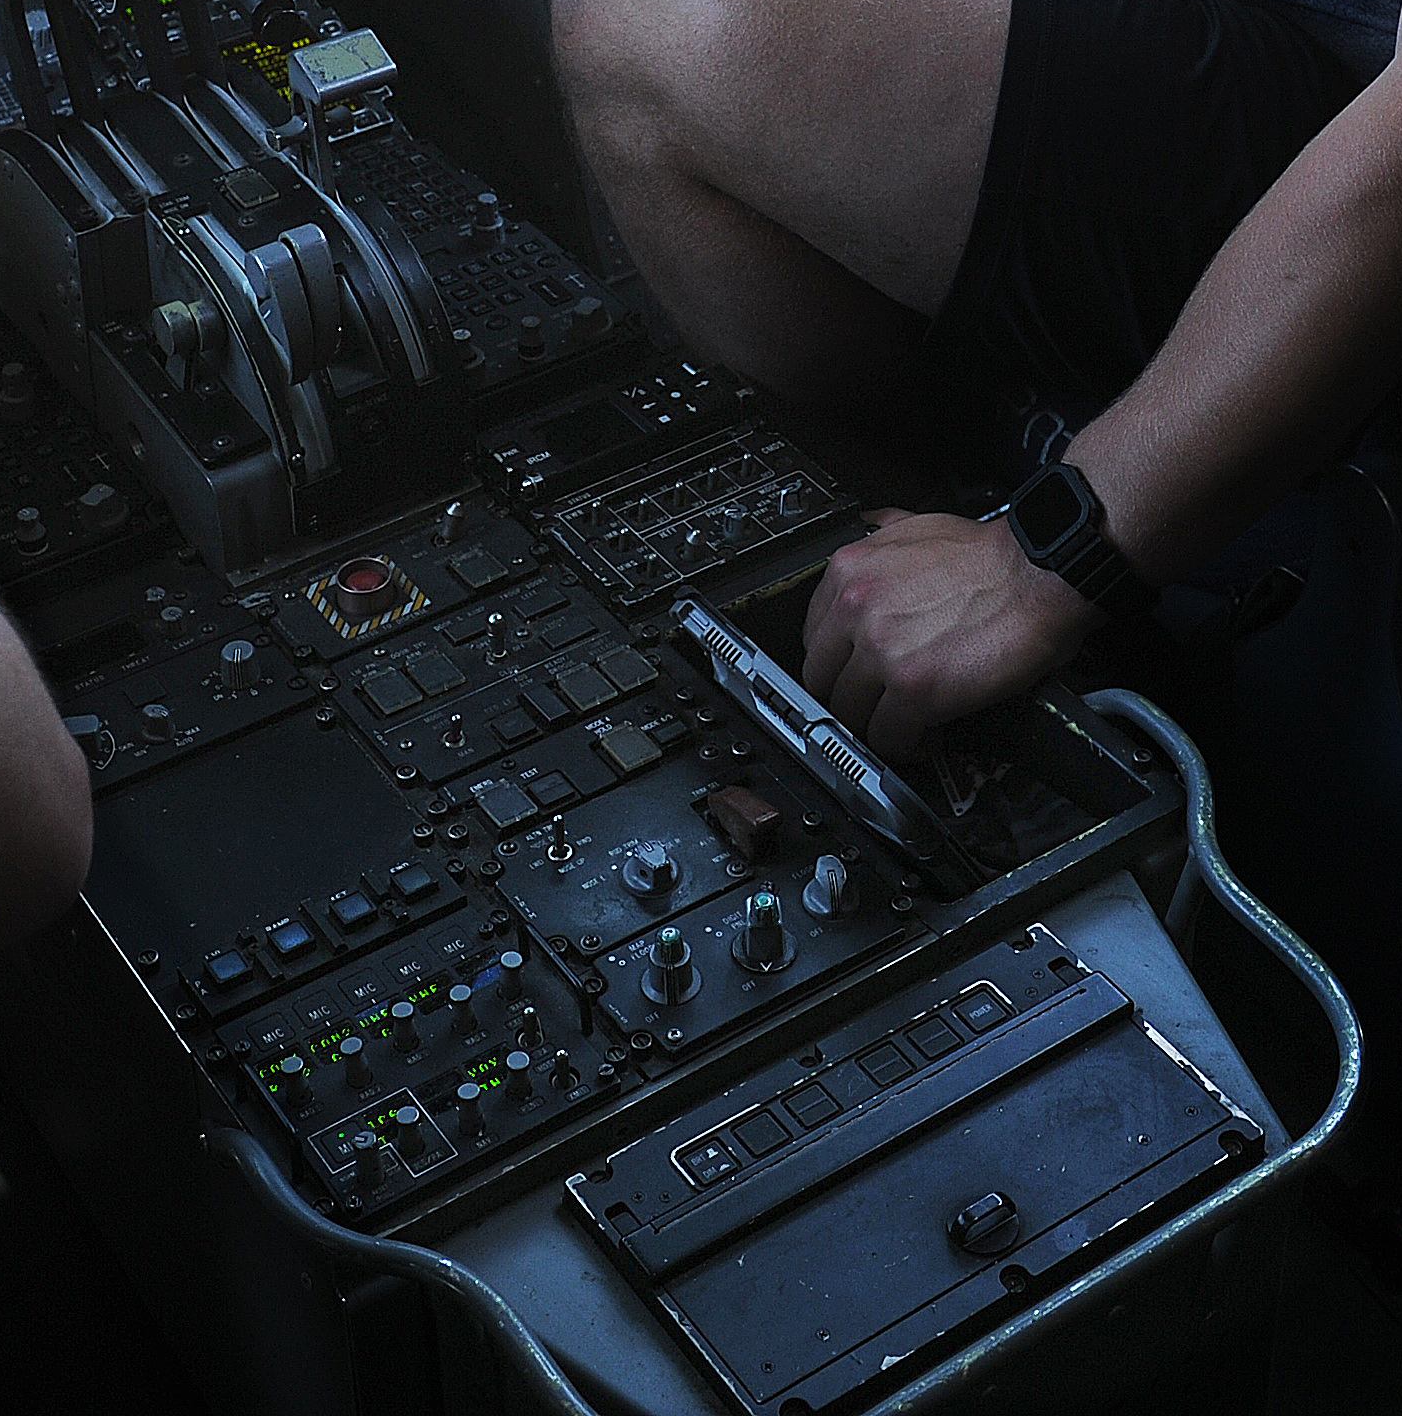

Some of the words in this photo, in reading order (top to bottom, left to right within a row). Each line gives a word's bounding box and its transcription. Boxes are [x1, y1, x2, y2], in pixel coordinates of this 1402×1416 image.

[74, 675, 105, 692] STATUS
[120, 655, 150, 672] THREAT
[519, 767, 539, 781] TEST
[809, 926, 825, 939] OFF
[443, 939, 466, 955] MIC
[628, 939, 646, 953] MAP
[398, 961, 421, 977] MIC
[353, 982, 377, 999] MIC
[741, 979, 757, 992] OFF
[307, 1005, 331, 1022] MIC
[644, 1011, 661, 1024] OFF
[969, 1003, 994, 1020] POWER
[262, 1027, 285, 1044] MIC
[691, 1154, 706, 1167] BRT
[702, 1166, 718, 1179] DIM
